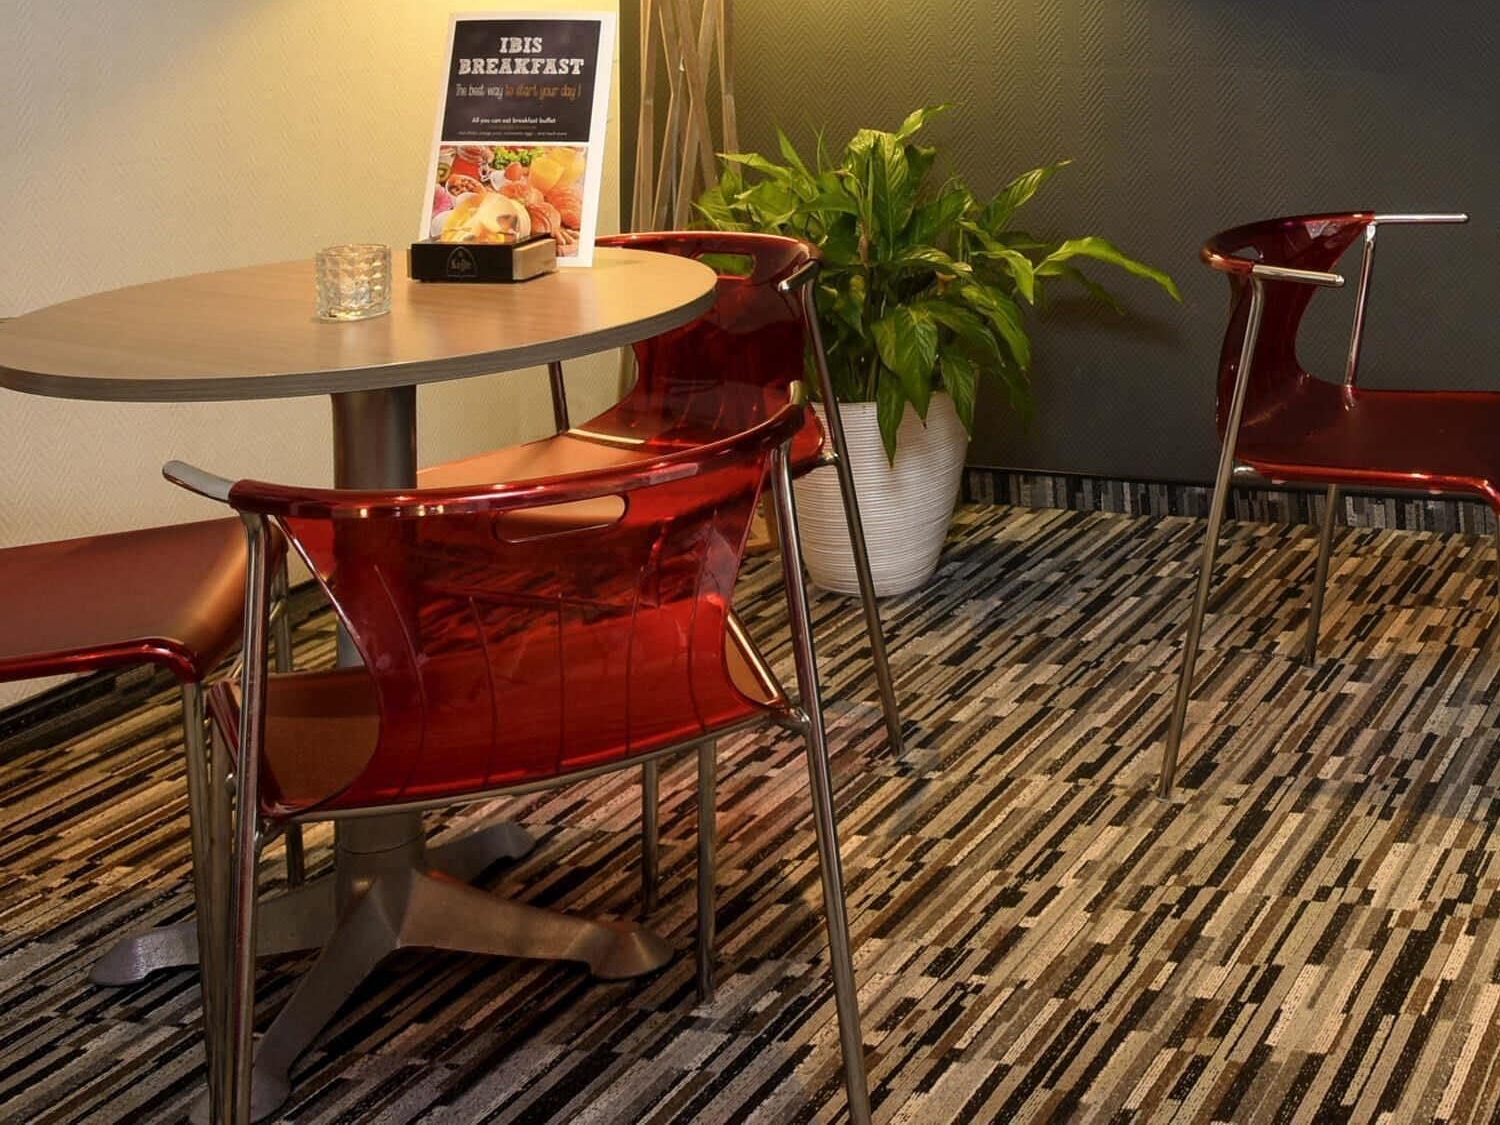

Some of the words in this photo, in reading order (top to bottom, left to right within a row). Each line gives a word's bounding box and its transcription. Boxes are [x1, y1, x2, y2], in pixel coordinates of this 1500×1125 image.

[499, 37, 543, 54] IBIS
[458, 58, 585, 75] BREAKFAST
[487, 85, 504, 100] way
